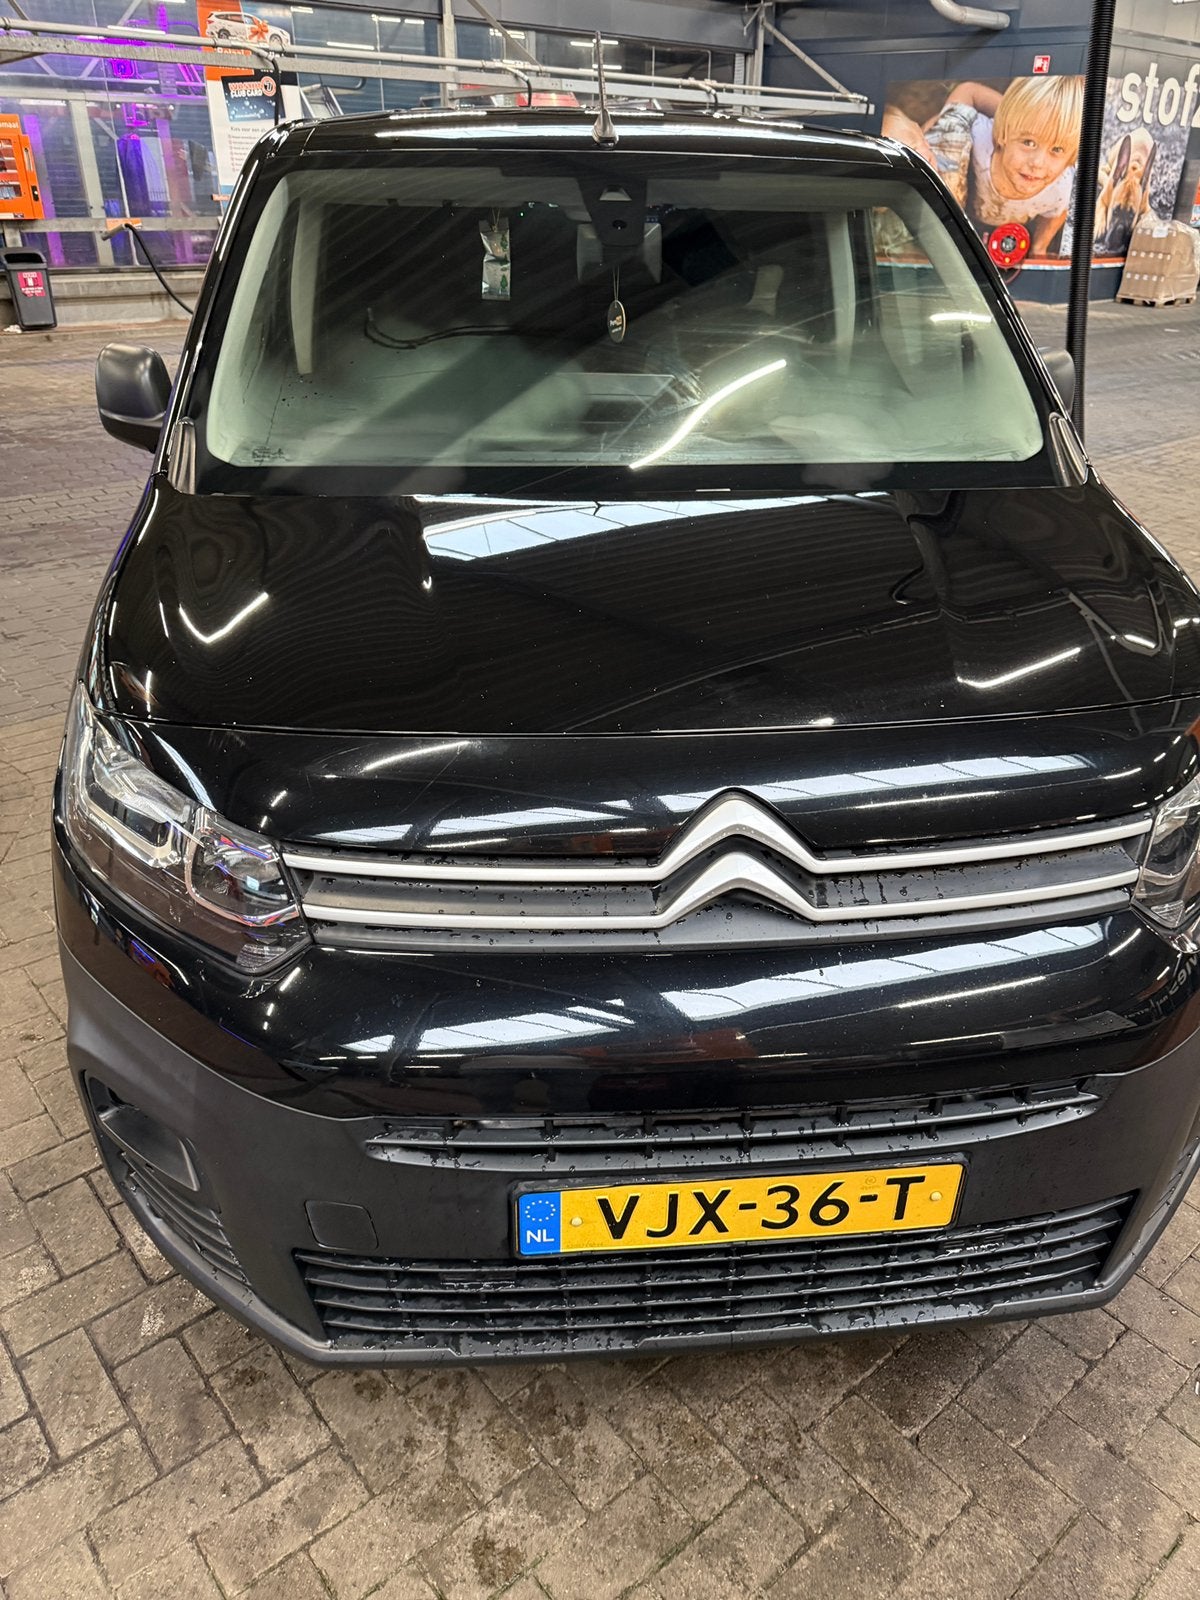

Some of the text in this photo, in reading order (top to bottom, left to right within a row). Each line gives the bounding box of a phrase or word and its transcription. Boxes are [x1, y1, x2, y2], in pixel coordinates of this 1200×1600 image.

[230, 89, 246, 98] CLUB
[597, 1175, 926, 1240] VJX-36-T
[526, 1229, 555, 1244] NL
